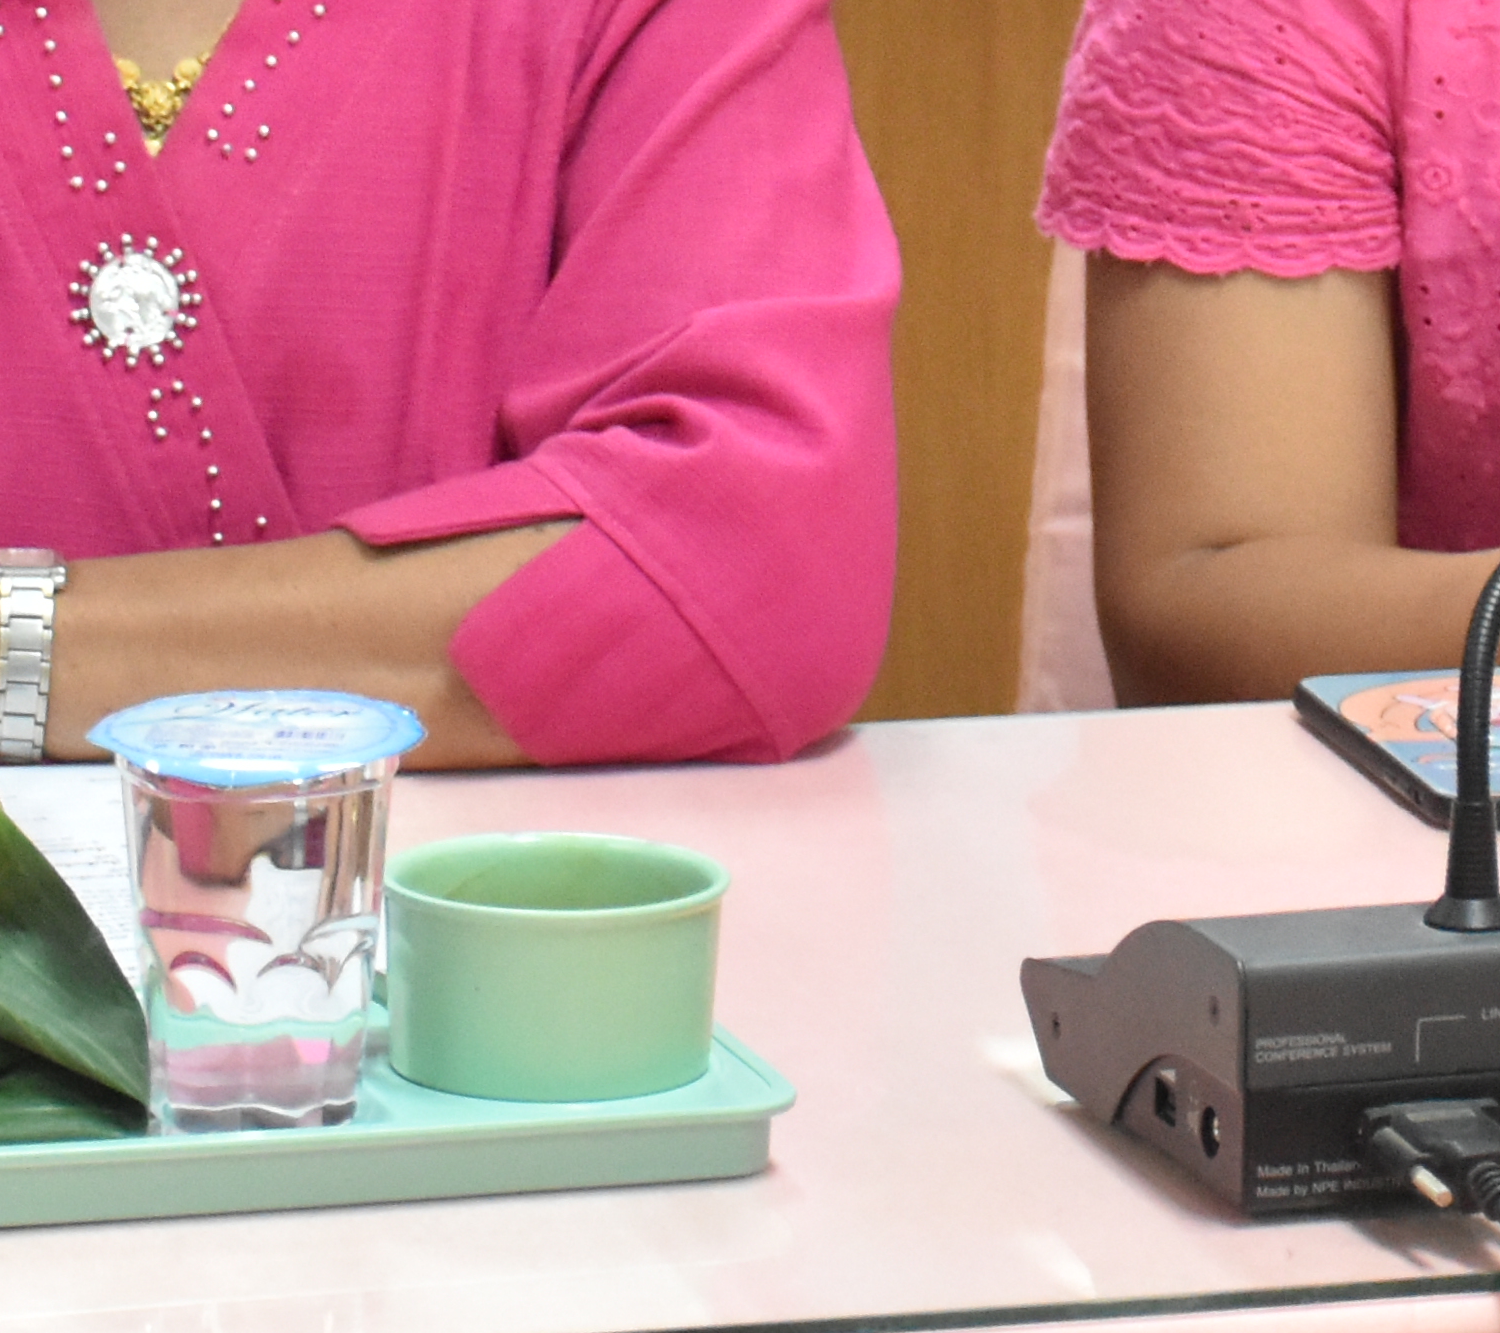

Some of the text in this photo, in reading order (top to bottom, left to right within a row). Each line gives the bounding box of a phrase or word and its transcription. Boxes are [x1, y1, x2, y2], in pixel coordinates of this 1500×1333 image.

[1254, 1033, 1346, 1050] PROFESSIONAL
[1254, 1041, 1393, 1064] CONFERENCE SYSTEM
[1256, 1164, 1293, 1178] Made
[1314, 1159, 1361, 1173] Thailan
[1255, 1185, 1291, 1198] Made
[1294, 1183, 1308, 1198] by
[1312, 1181, 1340, 1194] NPE
